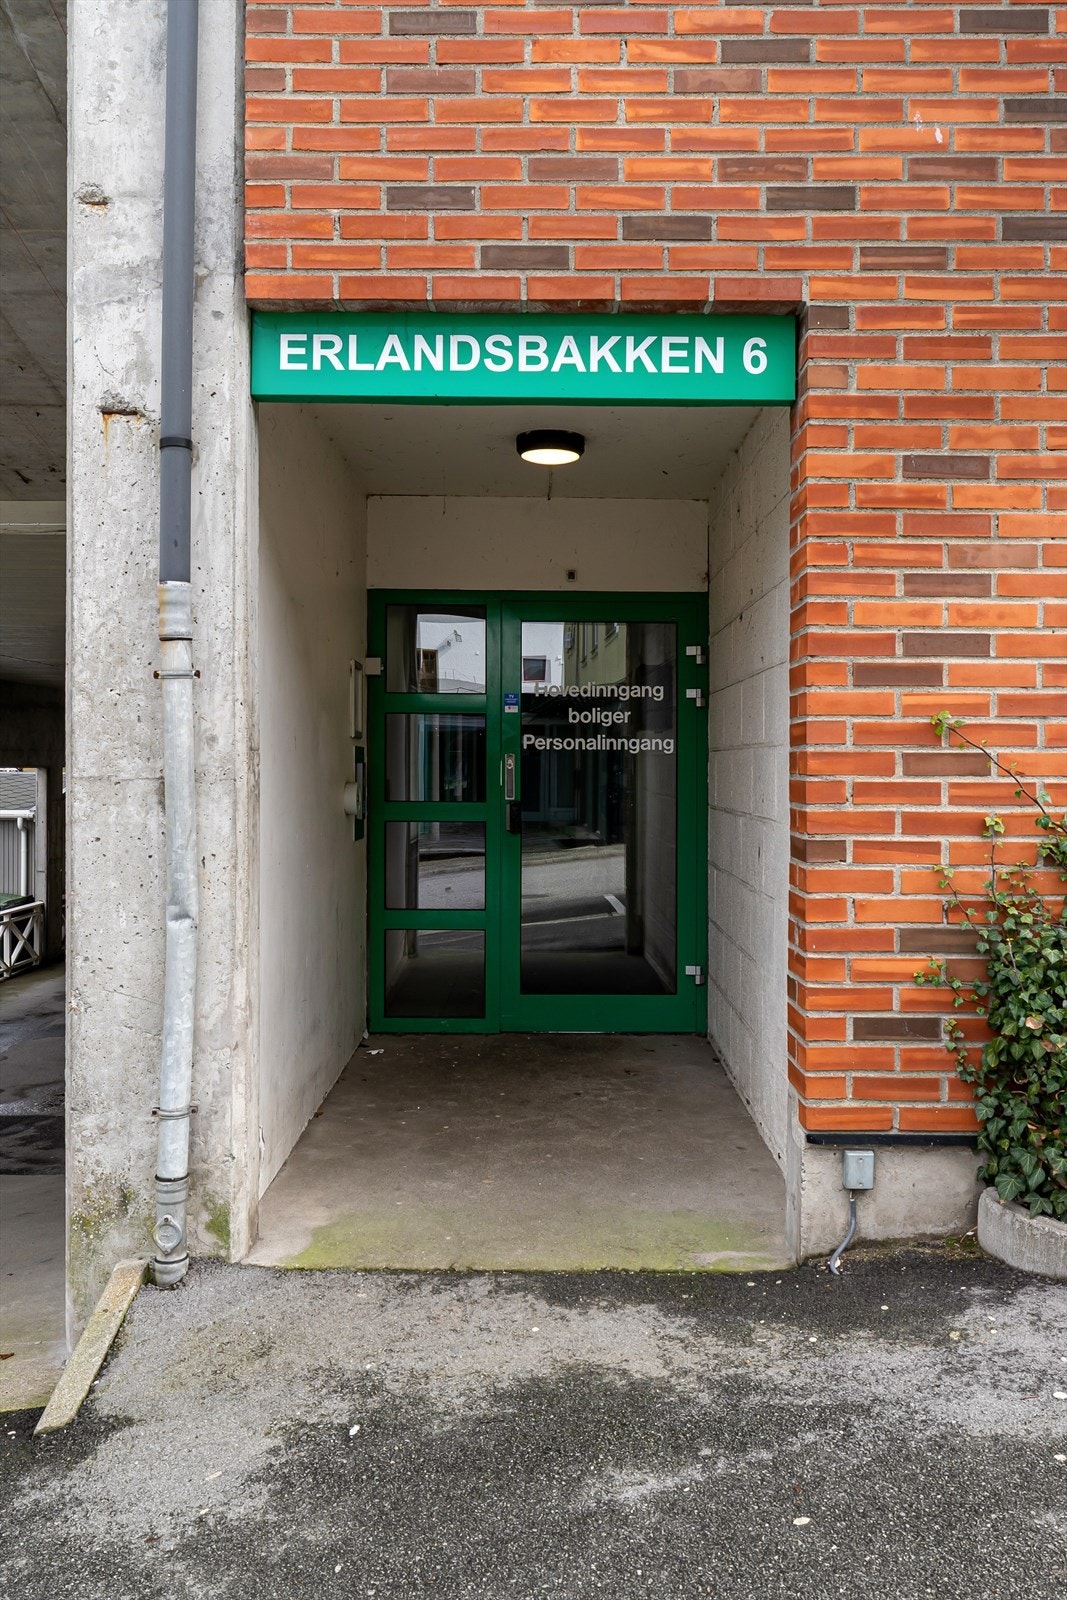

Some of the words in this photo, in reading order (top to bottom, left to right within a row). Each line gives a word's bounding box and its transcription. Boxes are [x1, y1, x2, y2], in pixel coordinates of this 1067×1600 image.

[279, 333, 725, 374] ERLANDSBAKKEN
[743, 337, 768, 375] 6
[534, 681, 664, 701] Hovedinngang
[568, 707, 632, 727] boliger
[522, 734, 675, 754] Personalinngang
